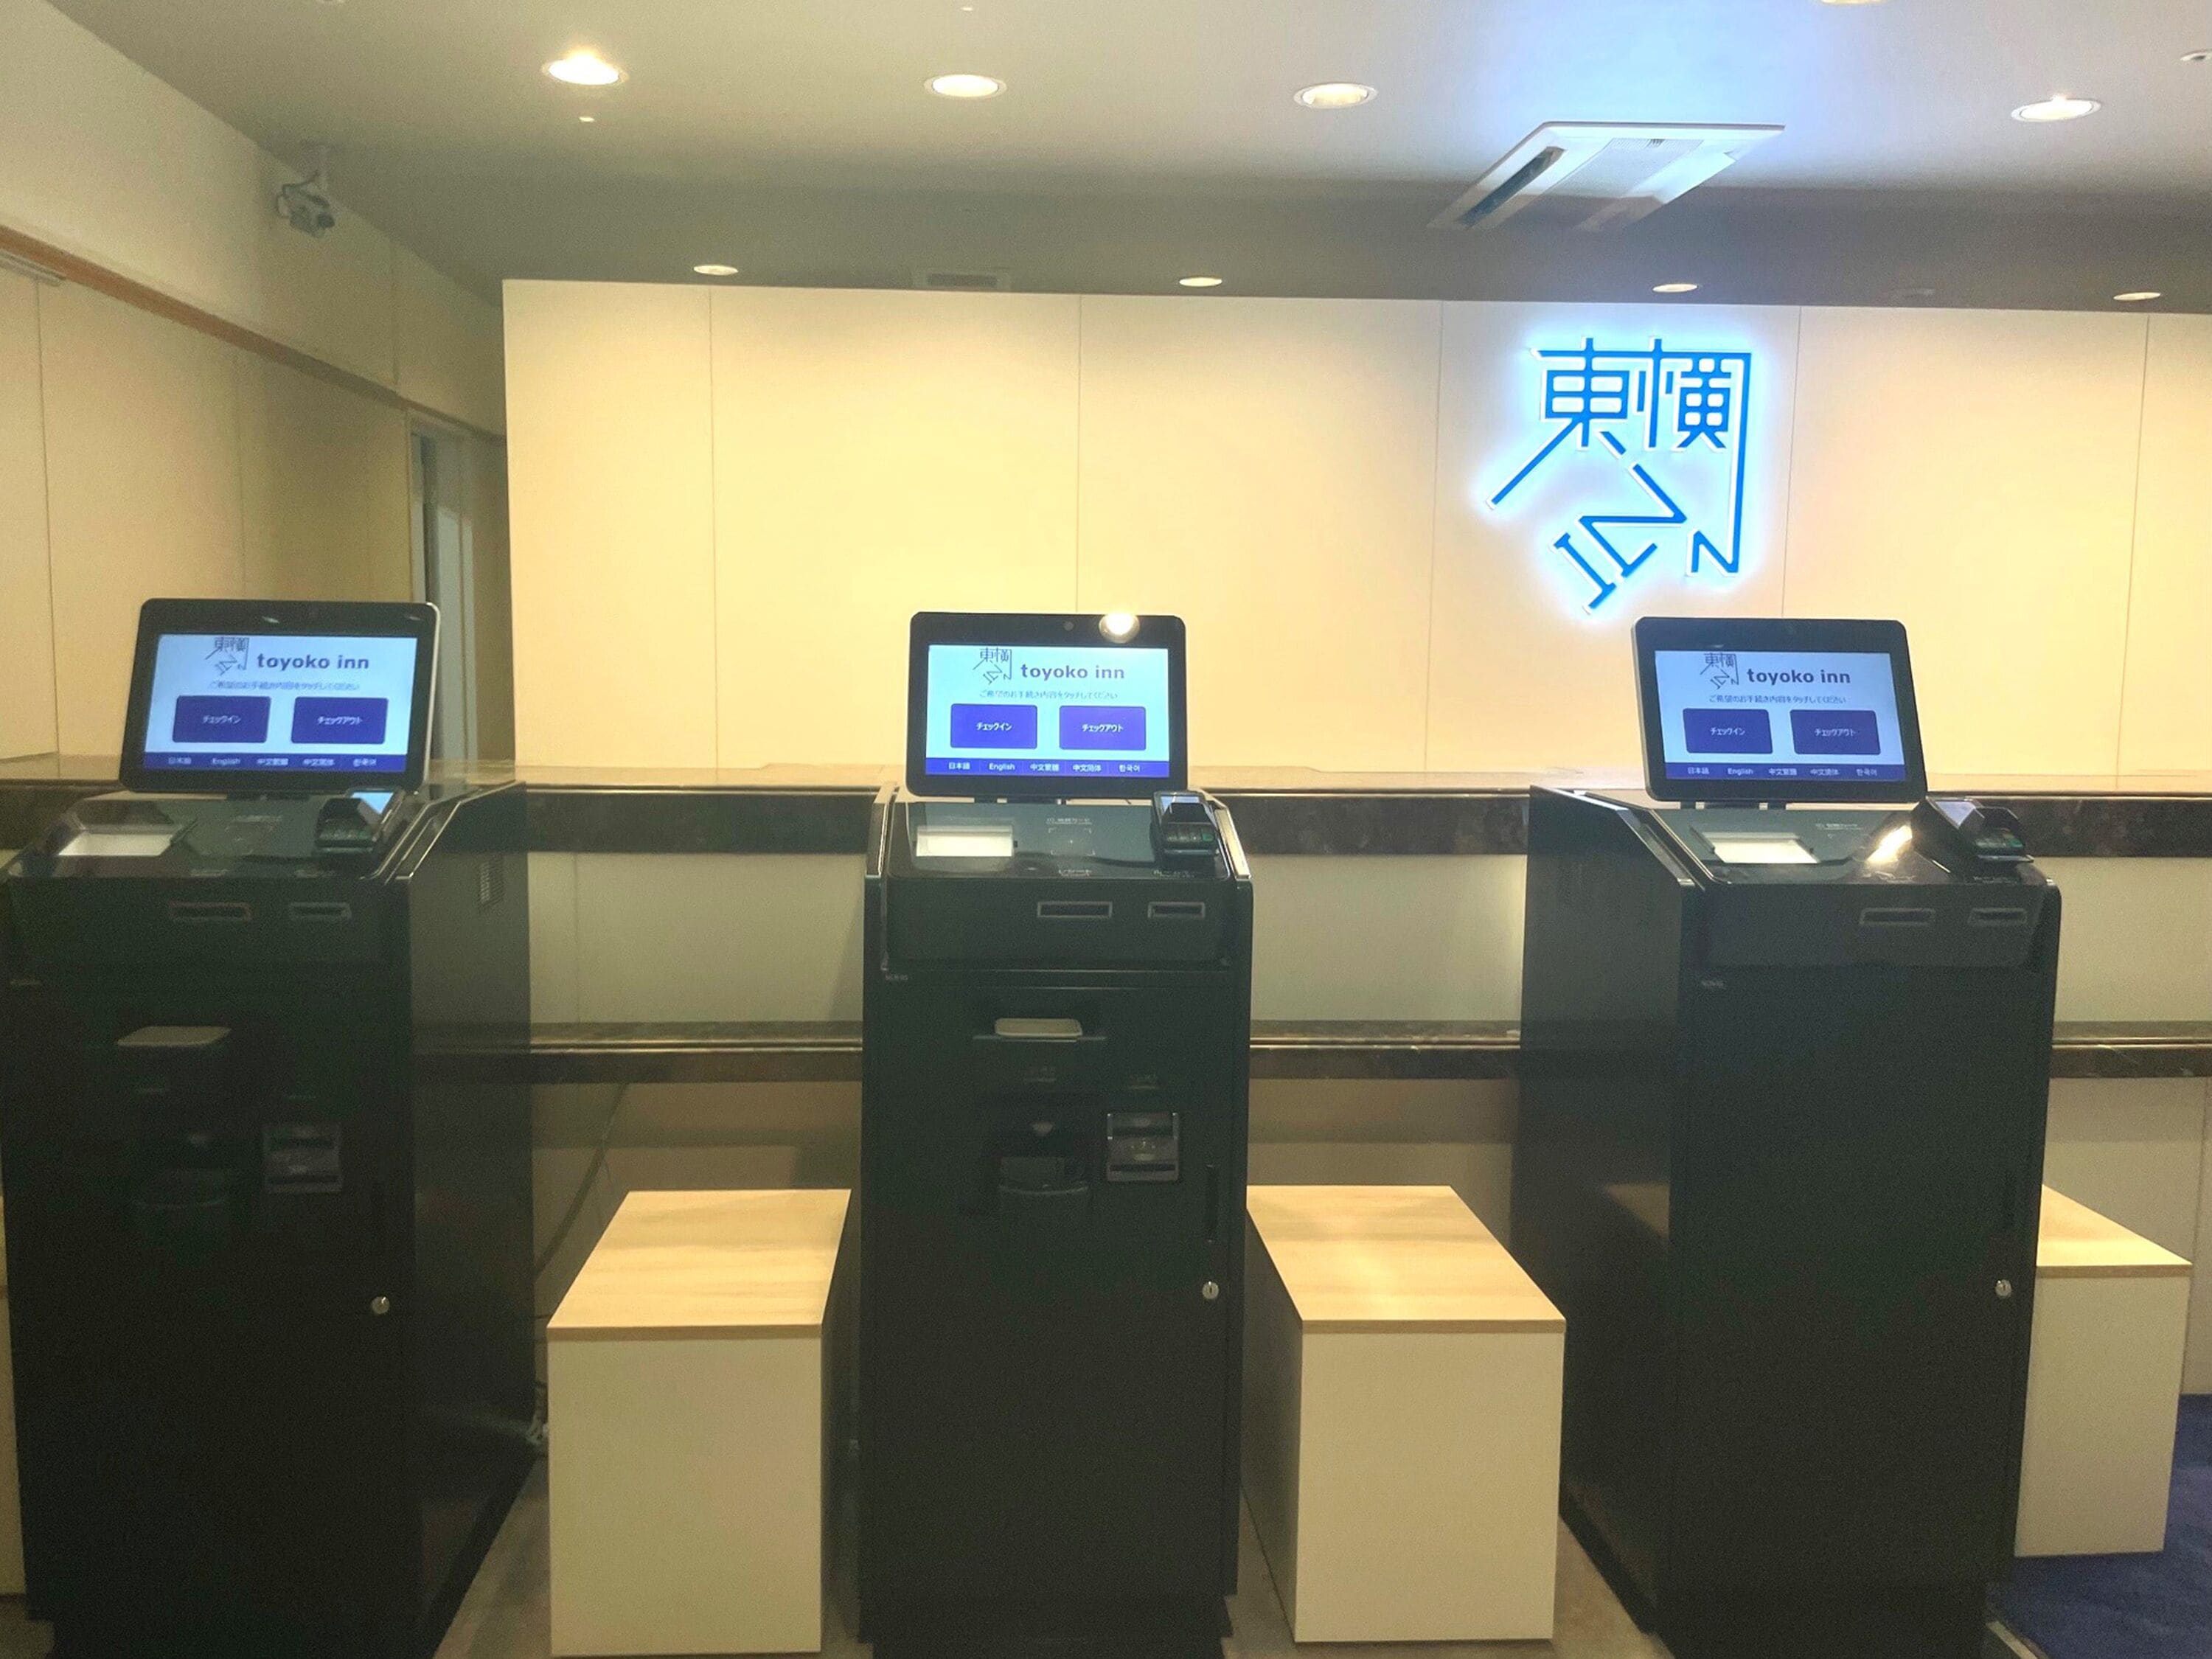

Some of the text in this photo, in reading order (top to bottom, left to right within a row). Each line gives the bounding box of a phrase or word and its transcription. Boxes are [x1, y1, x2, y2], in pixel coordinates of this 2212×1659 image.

[257, 653, 369, 671] toyoko inn
[1020, 664, 1124, 681] toyoko inn
[1747, 668, 1851, 686] toyoko inn
[976, 722, 1124, 733] チェックイン チェックアウト
[1710, 727, 1856, 737] チェックイン チェックアウト
[212, 757, 240, 765] English
[948, 762, 970, 770] 日本語
[989, 762, 1015, 771] English
[1727, 768, 1754, 776] English
